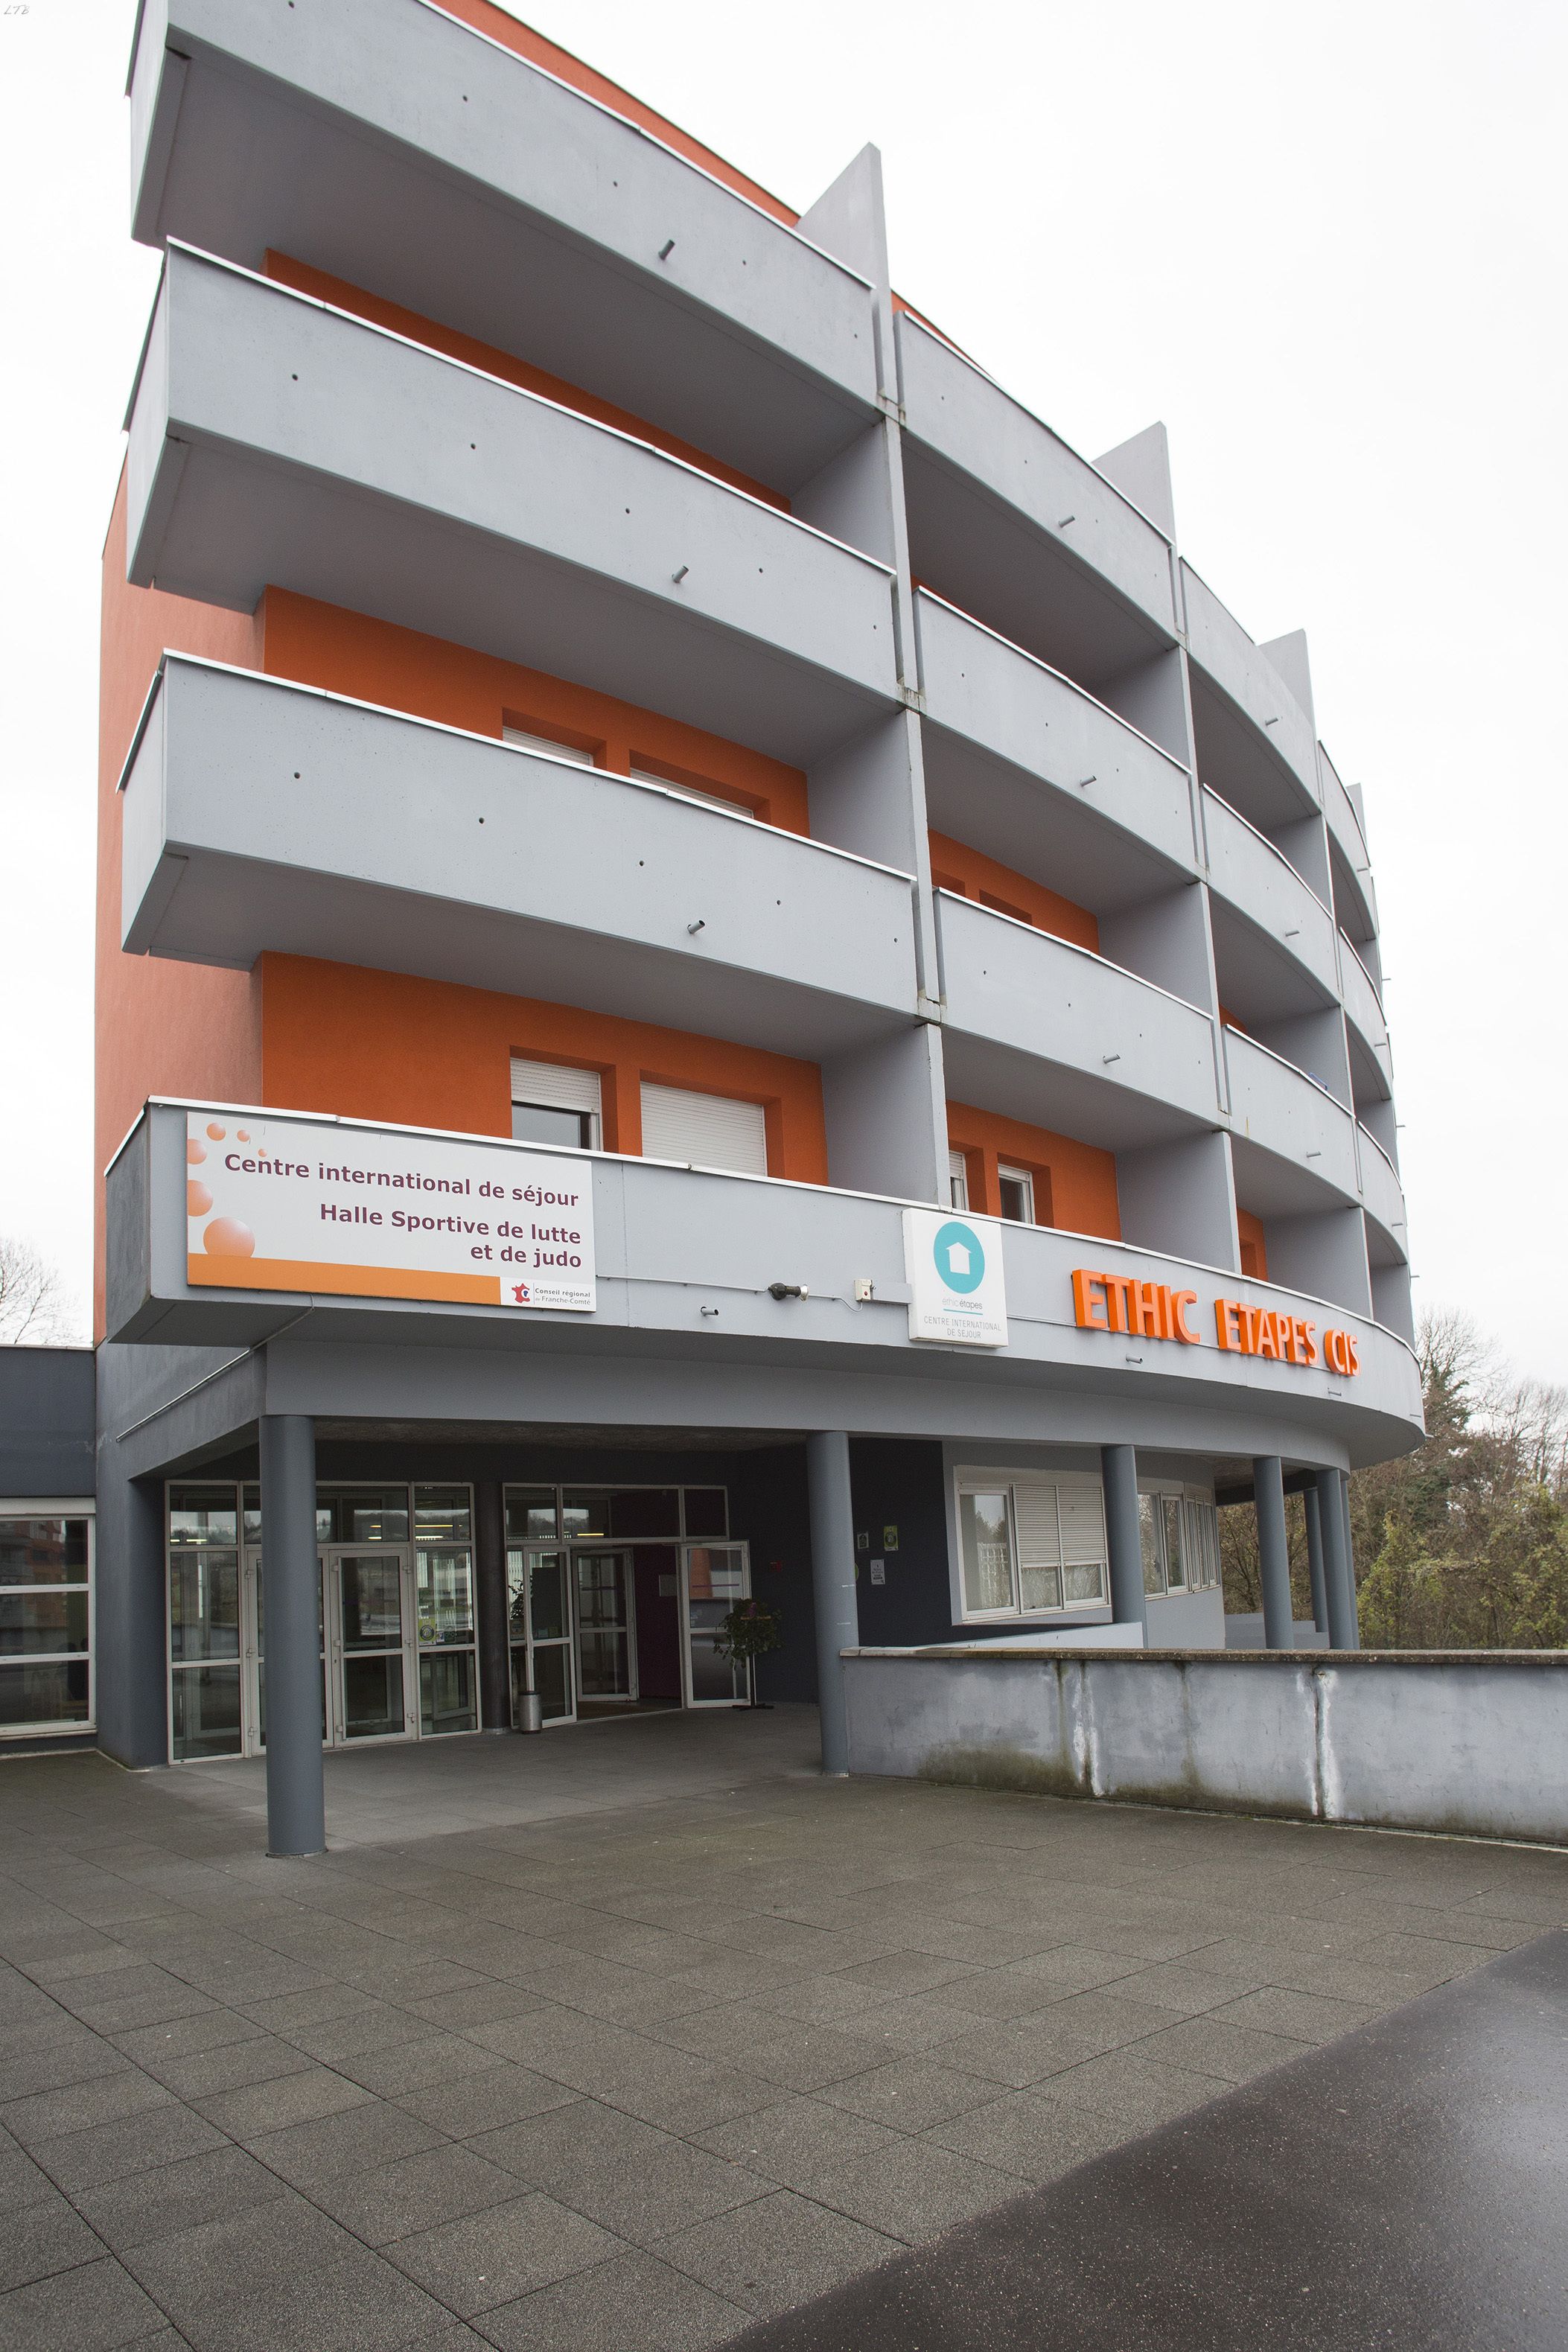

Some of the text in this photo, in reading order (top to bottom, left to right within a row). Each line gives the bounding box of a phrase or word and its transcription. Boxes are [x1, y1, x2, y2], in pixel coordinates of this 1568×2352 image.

[225, 1153, 579, 1206] Centre international de séjour
[320, 1203, 581, 1244] Halle Sportive de lutte
[471, 1244, 582, 1268] et de judo
[535, 1287, 591, 1298] Conseil régional
[541, 1295, 591, 1305] Franche-Comté
[959, 1298, 984, 1310] étapes
[923, 1316, 1001, 1331] CENTRE INTERNATIONAL
[1071, 1268, 1362, 1377] ETHIC ETAPES CIS
[946, 1328, 982, 1339] DE SEJOUR
